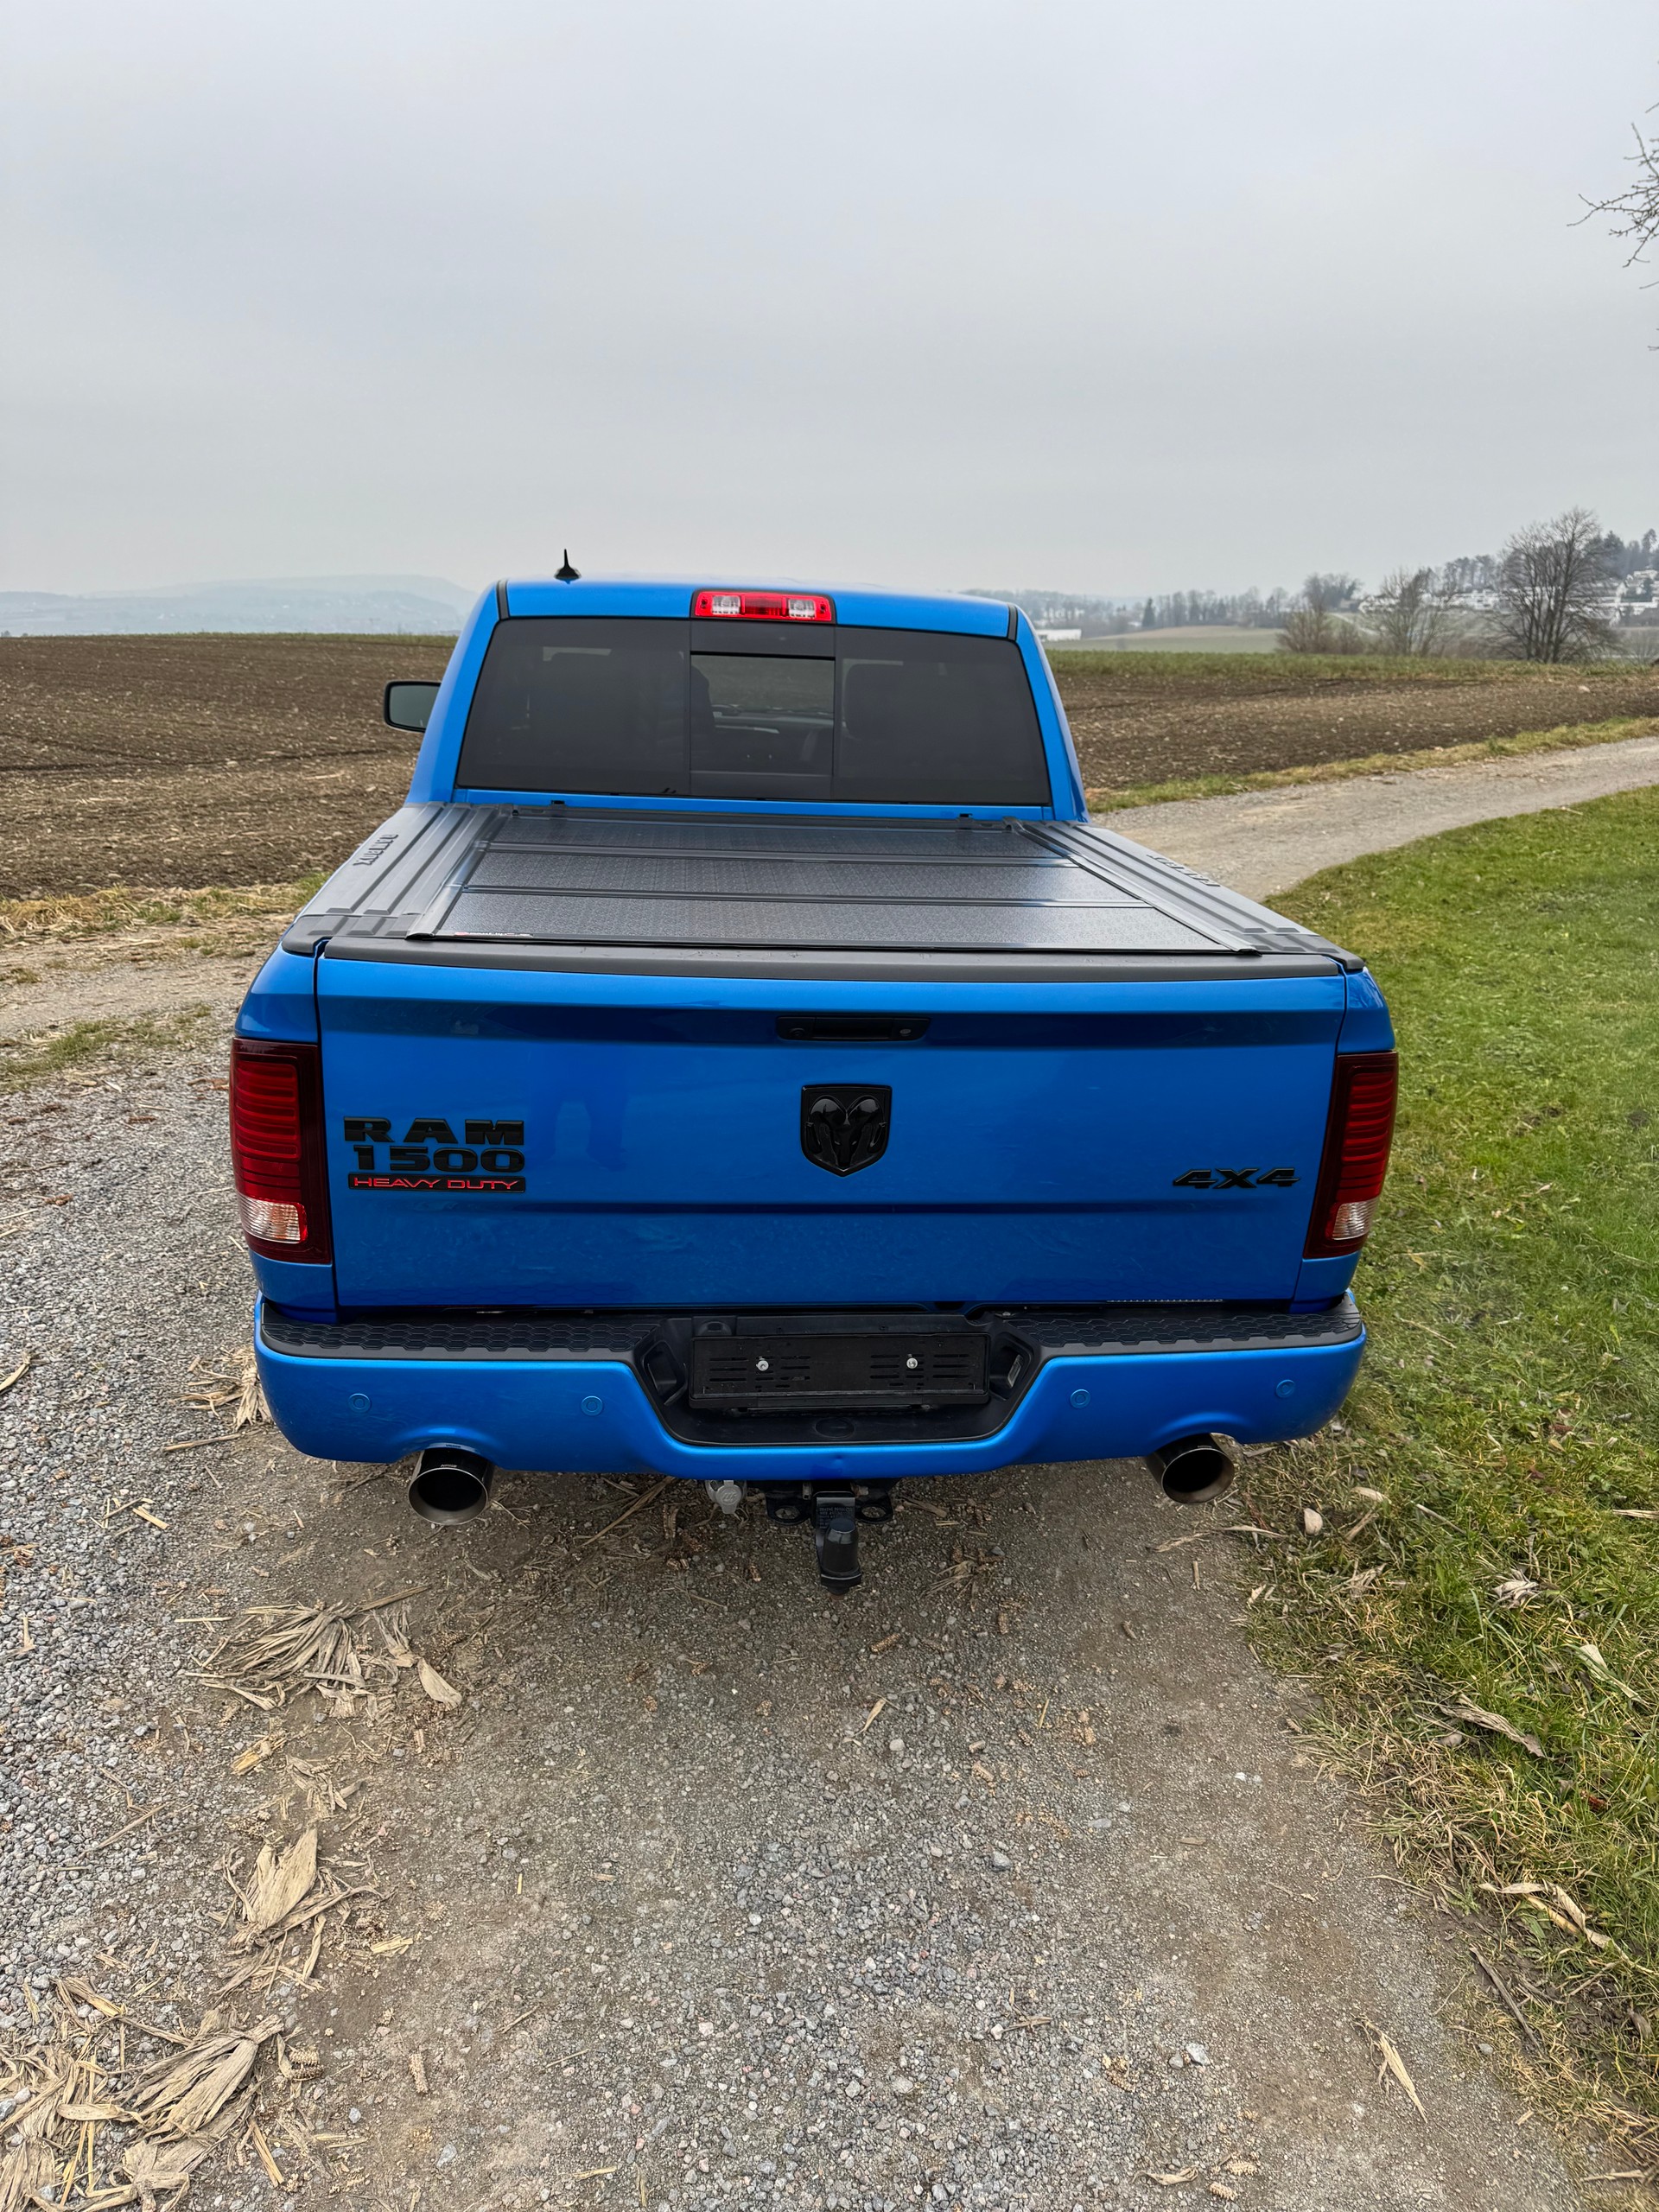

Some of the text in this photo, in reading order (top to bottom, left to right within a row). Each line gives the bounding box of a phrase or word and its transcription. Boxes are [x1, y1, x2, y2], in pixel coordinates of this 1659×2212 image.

[343, 1116, 525, 1146] RAM
[353, 1145, 525, 1173] 1500
[353, 1177, 519, 1190] HEAVY DUTY
[1172, 1167, 1300, 1189] 4X4
